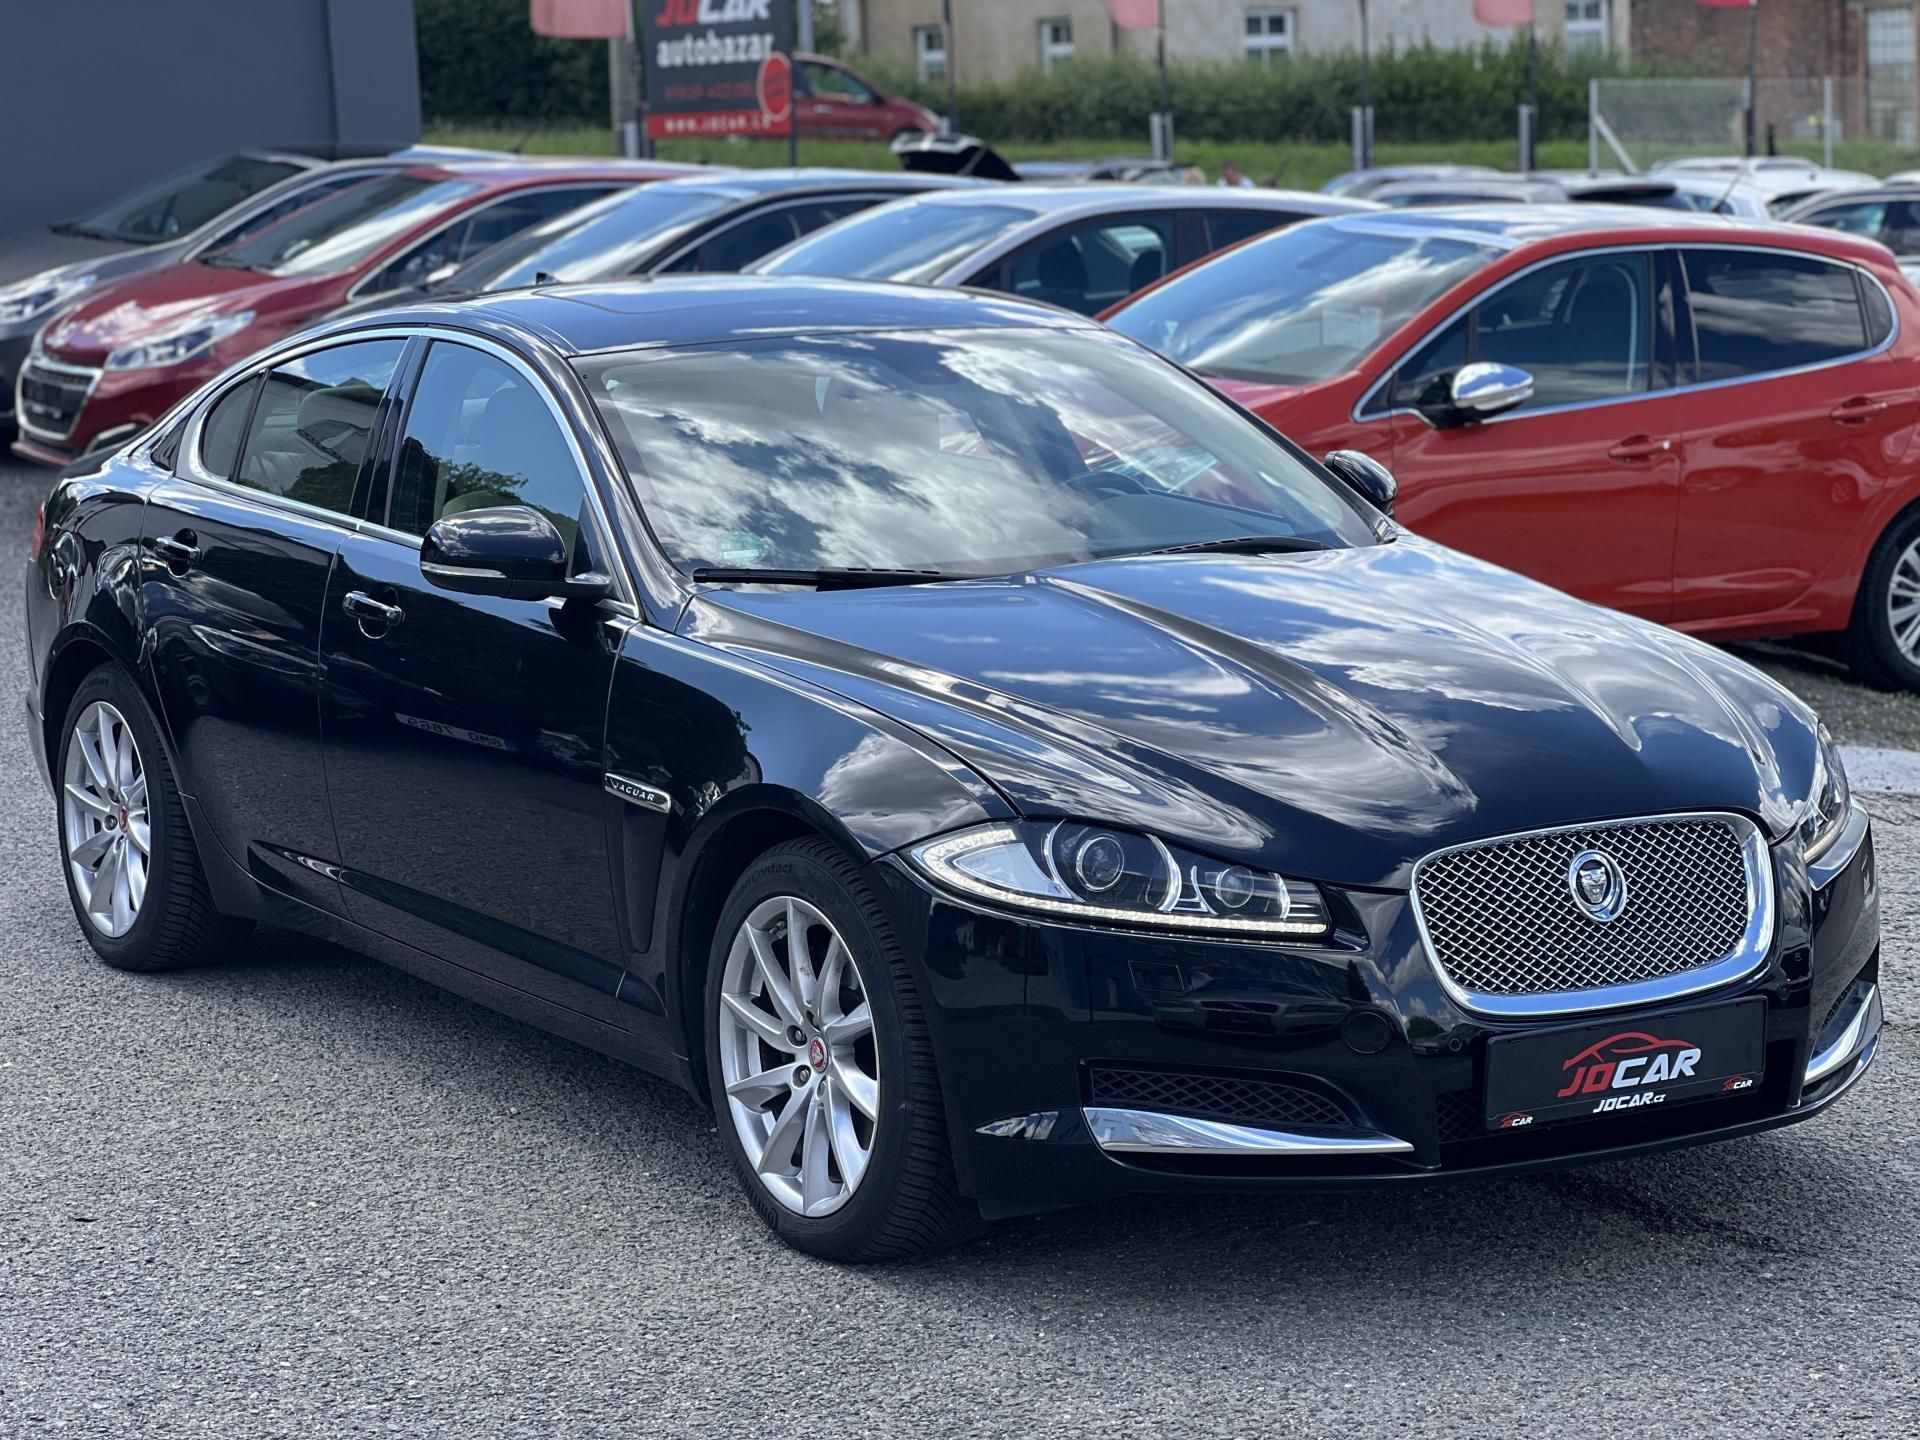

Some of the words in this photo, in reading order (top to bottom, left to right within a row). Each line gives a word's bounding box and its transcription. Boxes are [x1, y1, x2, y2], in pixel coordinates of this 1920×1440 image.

[656, 29, 775, 68] autobazar
[609, 778, 655, 801] JAGUAR
[1557, 1048, 1701, 1098] JOCAR
[1722, 1079, 1753, 1092] JOCAR
[1592, 1092, 1666, 1113] JOCAR.cz
[1500, 1116, 1533, 1128] JOCAR
